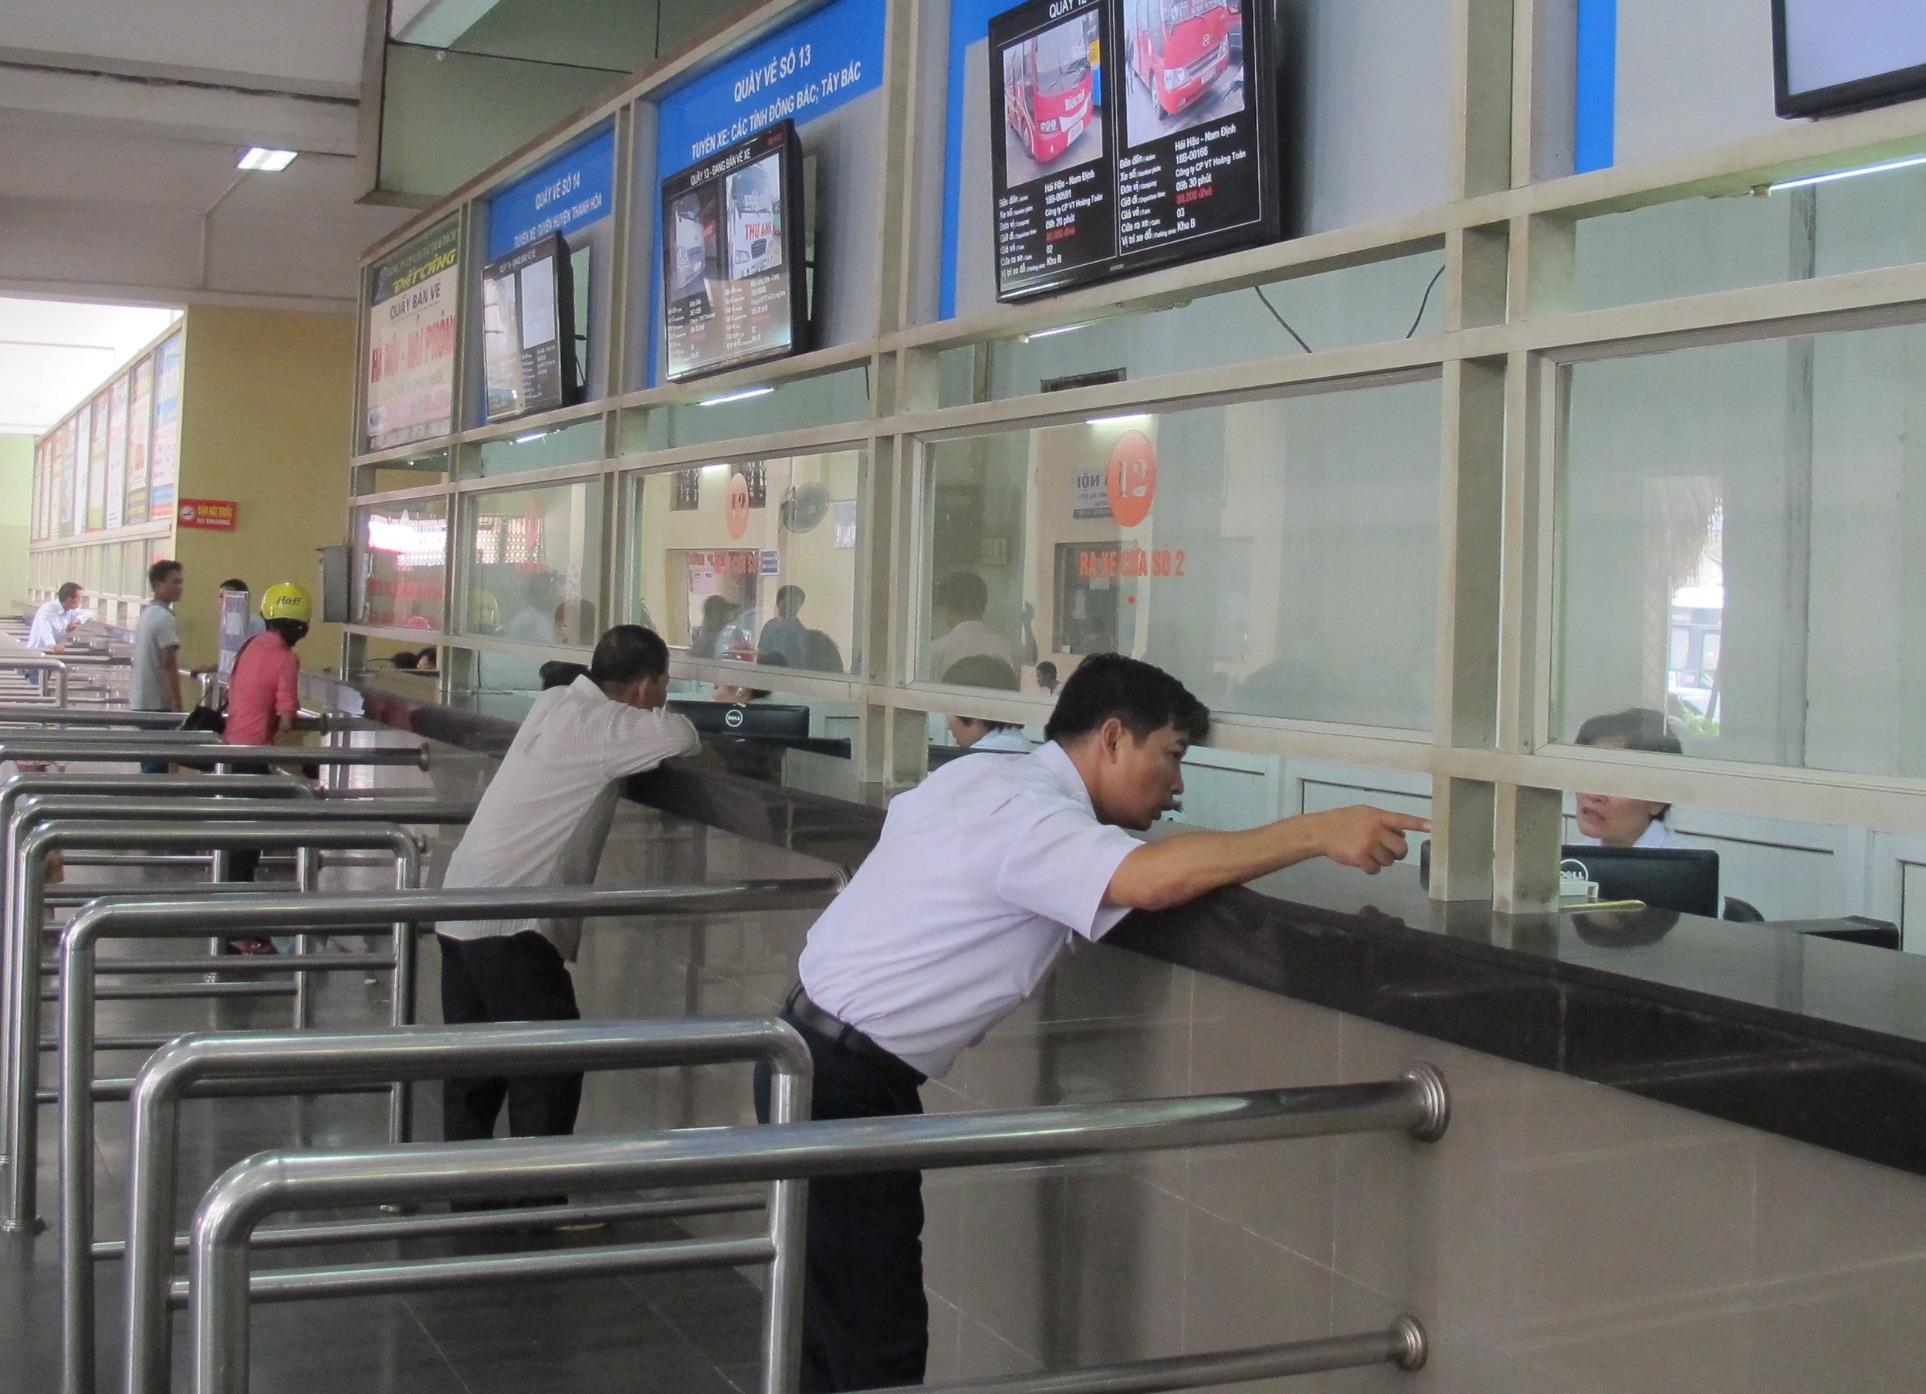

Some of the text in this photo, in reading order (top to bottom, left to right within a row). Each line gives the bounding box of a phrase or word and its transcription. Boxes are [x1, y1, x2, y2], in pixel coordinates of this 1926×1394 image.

[734, 44, 811, 103] QUẦY VÉ SỐ 13
[691, 130, 716, 161] TUYẾN
[717, 128, 730, 150] XE:
[731, 117, 748, 142] CÁC
[768, 97, 795, 123] ĐÔNG
[821, 71, 840, 97] TÂY
[841, 60, 862, 88] BẮC
[1190, 217, 1196, 228] B
[1559, 870, 1585, 880] DELL
